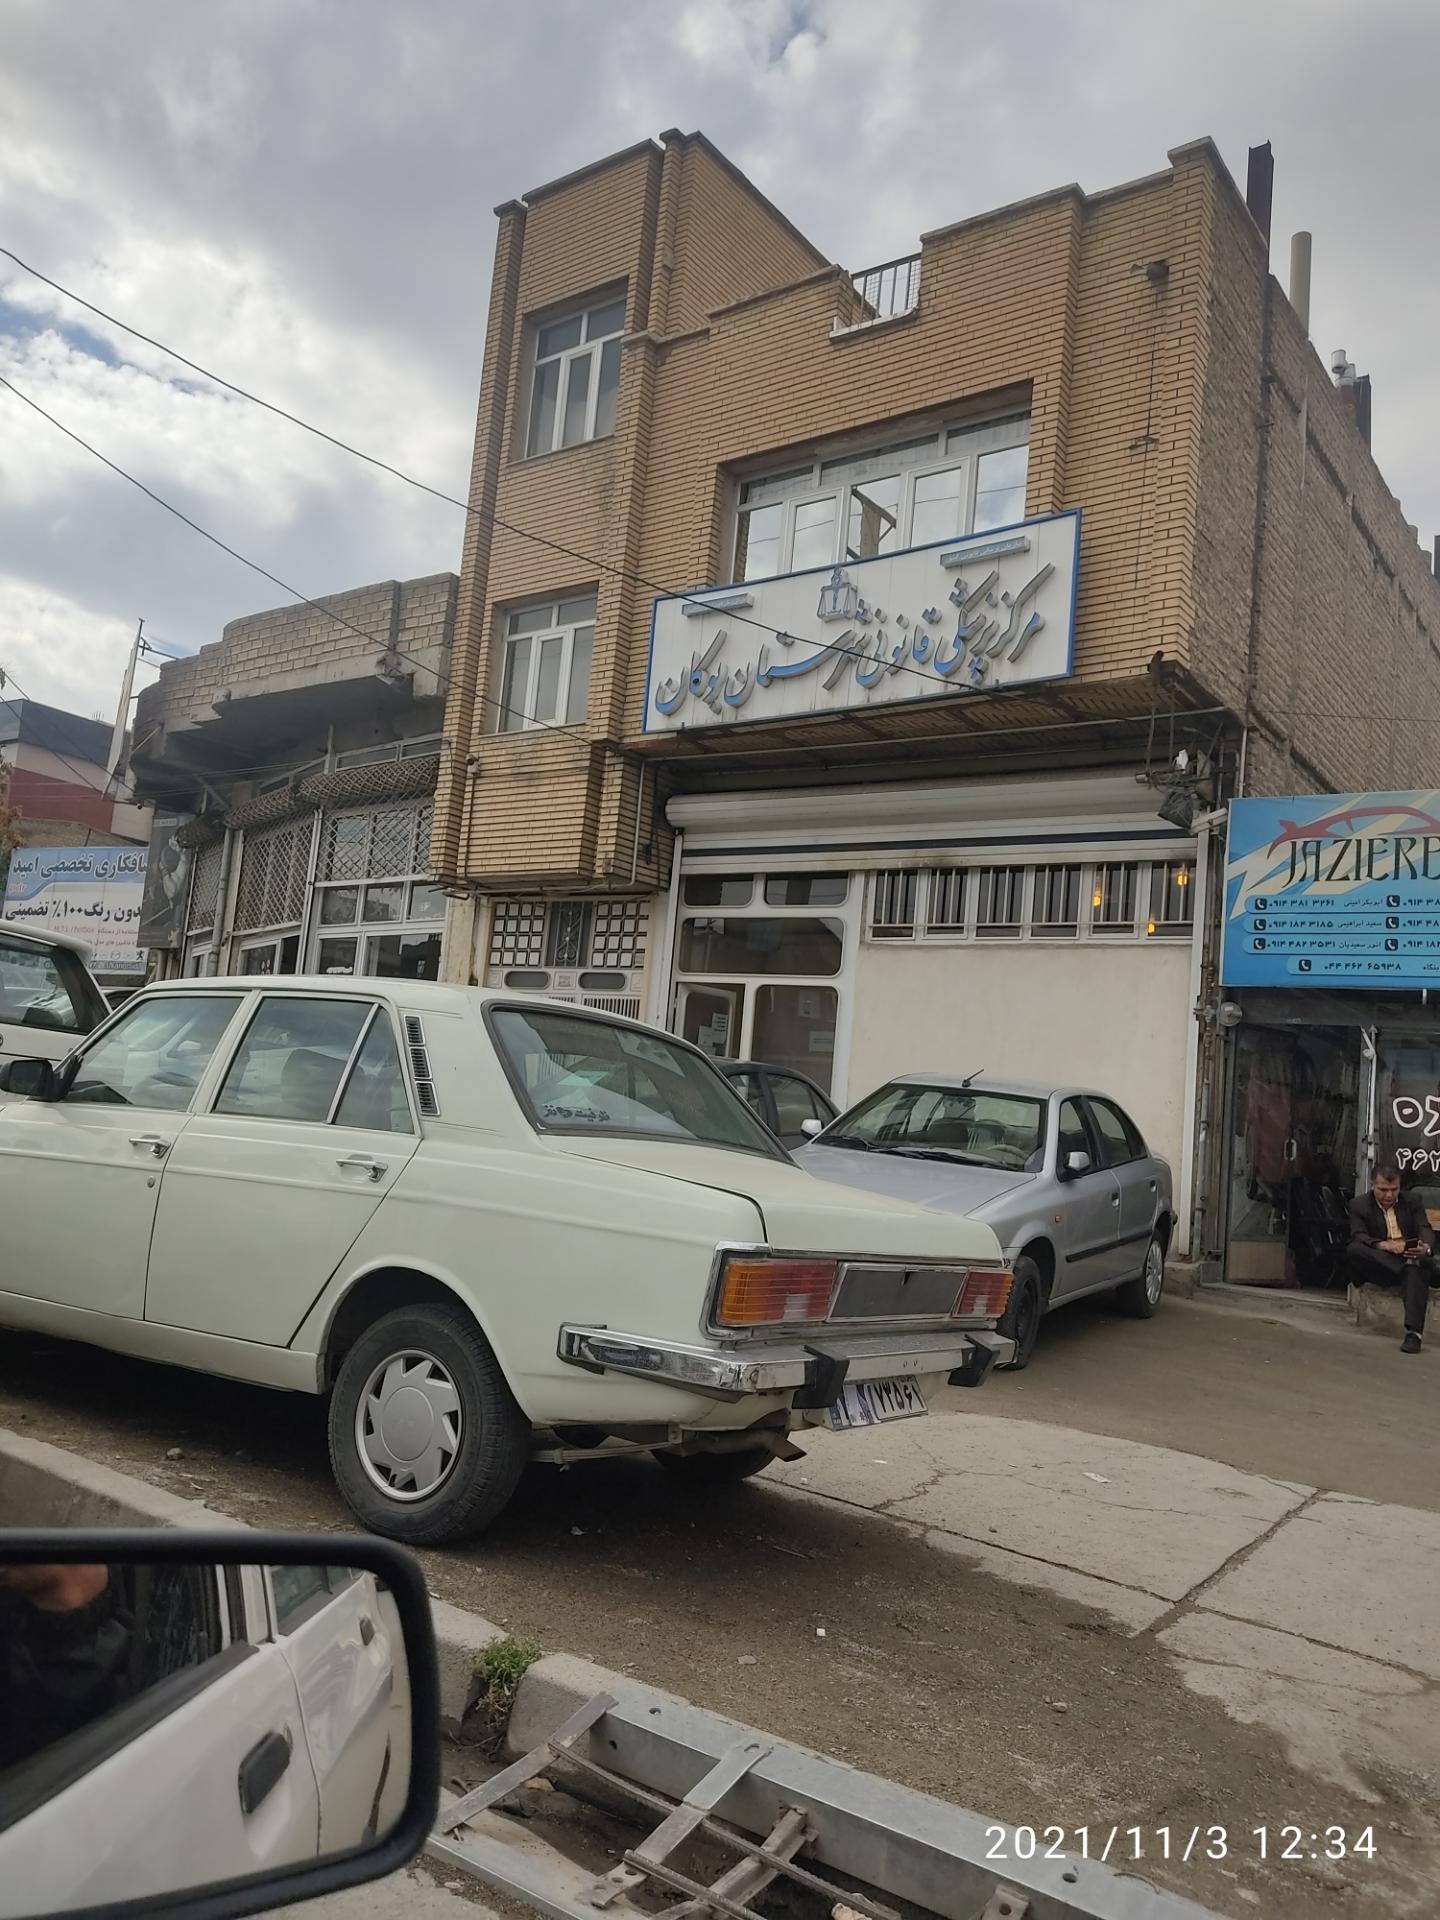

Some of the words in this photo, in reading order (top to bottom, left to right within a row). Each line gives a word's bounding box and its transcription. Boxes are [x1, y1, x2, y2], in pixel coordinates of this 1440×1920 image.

[933, 569, 1000, 685] پزشکی
[984, 562, 1057, 665] مرکز
[723, 598, 873, 710] شهرستان
[854, 606, 943, 690] قانونی
[655, 628, 728, 717] بوکان
[12, 855, 39, 876] امید
[41, 854, 94, 879] تخصصی
[95, 853, 148, 880] افکاری
[5, 901, 49, 921] تضمینی
[84, 899, 111, 922] رنگ
[114, 906, 141, 922] دون
